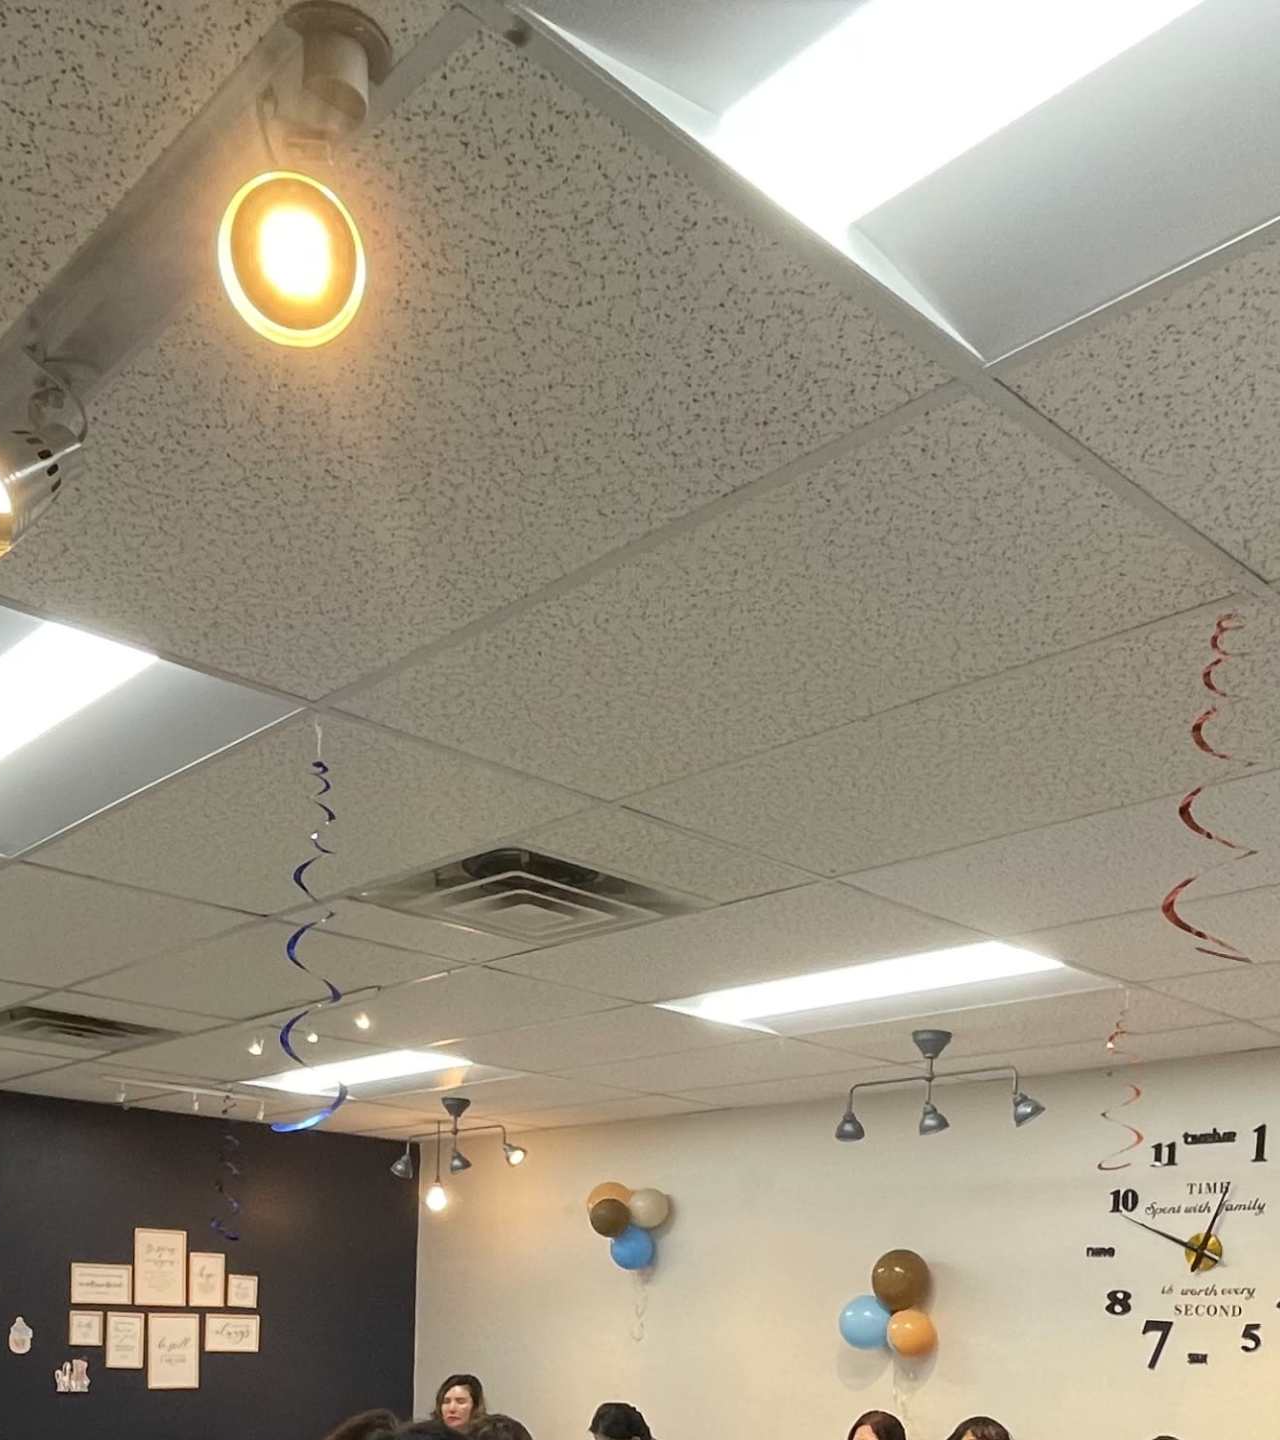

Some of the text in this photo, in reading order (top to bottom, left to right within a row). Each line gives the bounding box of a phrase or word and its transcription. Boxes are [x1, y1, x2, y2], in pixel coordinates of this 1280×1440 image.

[1150, 1142, 1178, 1167] 11
[1250, 1124, 1268, 1162] 1
[1108, 1188, 1139, 1213] 10
[1183, 1200, 1211, 1215] with
[1217, 1199, 1267, 1217] family
[1104, 1289, 1132, 1316] 8
[1180, 1286, 1218, 1297] worth
[1220, 1286, 1256, 1303] every
[1174, 1303, 1242, 1318] SECOND
[1142, 1319, 1173, 1370] 7
[1240, 1323, 1261, 1353] 5
